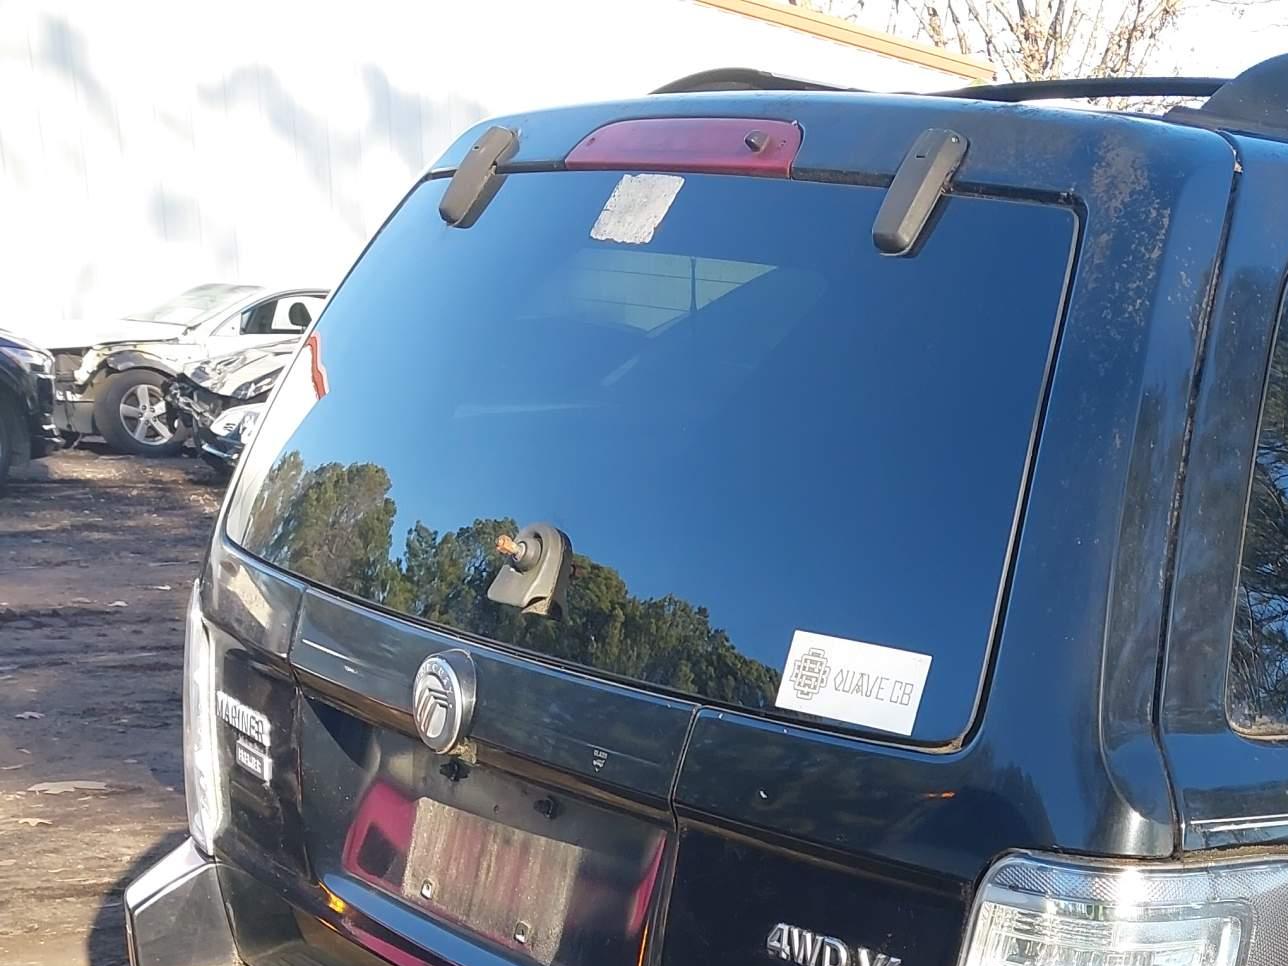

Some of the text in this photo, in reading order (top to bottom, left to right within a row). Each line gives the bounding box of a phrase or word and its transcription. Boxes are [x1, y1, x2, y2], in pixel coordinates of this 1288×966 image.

[833, 667, 914, 706] QUAVE CB
[216, 690, 271, 746] MARINER
